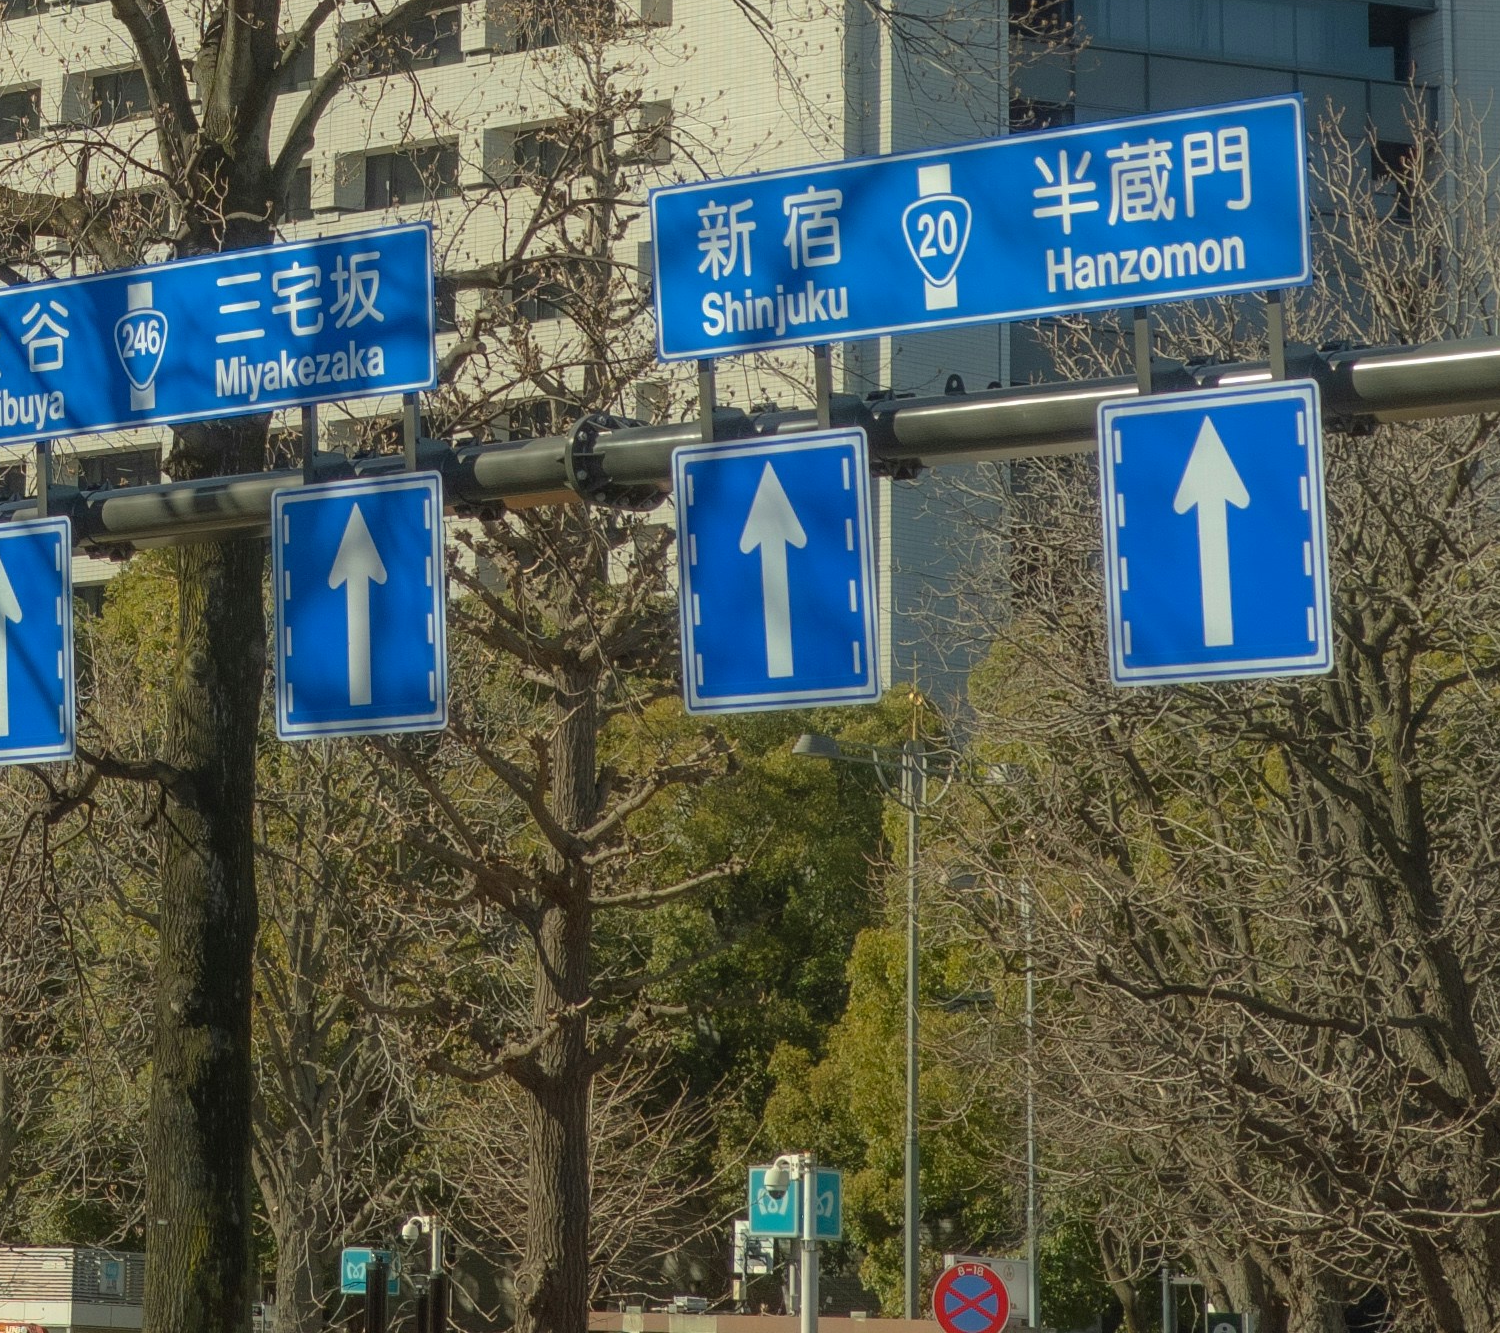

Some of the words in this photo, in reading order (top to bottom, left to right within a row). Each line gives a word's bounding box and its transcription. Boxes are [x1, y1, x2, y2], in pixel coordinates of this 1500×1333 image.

[1033, 126, 1252, 235] 半蔵門
[697, 185, 843, 281] 新宿
[917, 210, 958, 258] 20
[1046, 235, 1246, 293] Hanzomon
[215, 250, 385, 344] 三宅坂
[701, 280, 849, 337] Shinjuku
[122, 319, 161, 358] 246
[215, 340, 385, 402] Miyakezaka
[957, 1265, 984, 1276] 8-18
